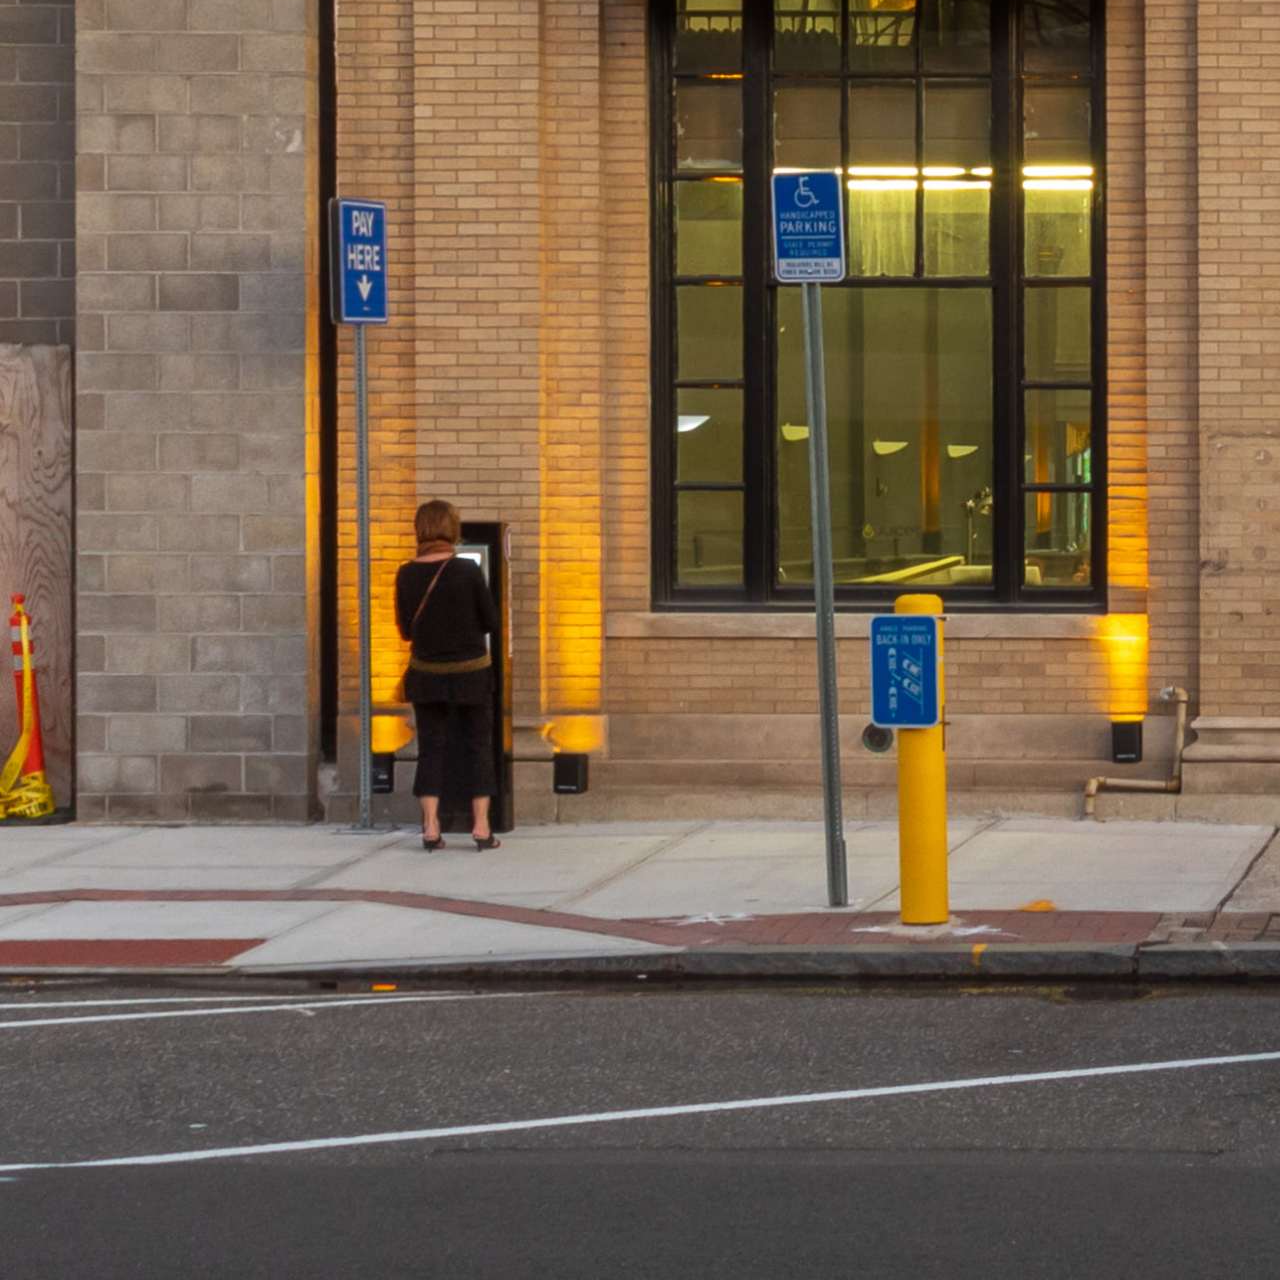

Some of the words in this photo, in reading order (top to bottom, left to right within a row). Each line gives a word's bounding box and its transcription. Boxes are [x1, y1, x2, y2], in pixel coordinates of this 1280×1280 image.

[352, 210, 374, 237] PAY
[780, 221, 836, 233] PARKING
[347, 244, 381, 272] HERE
